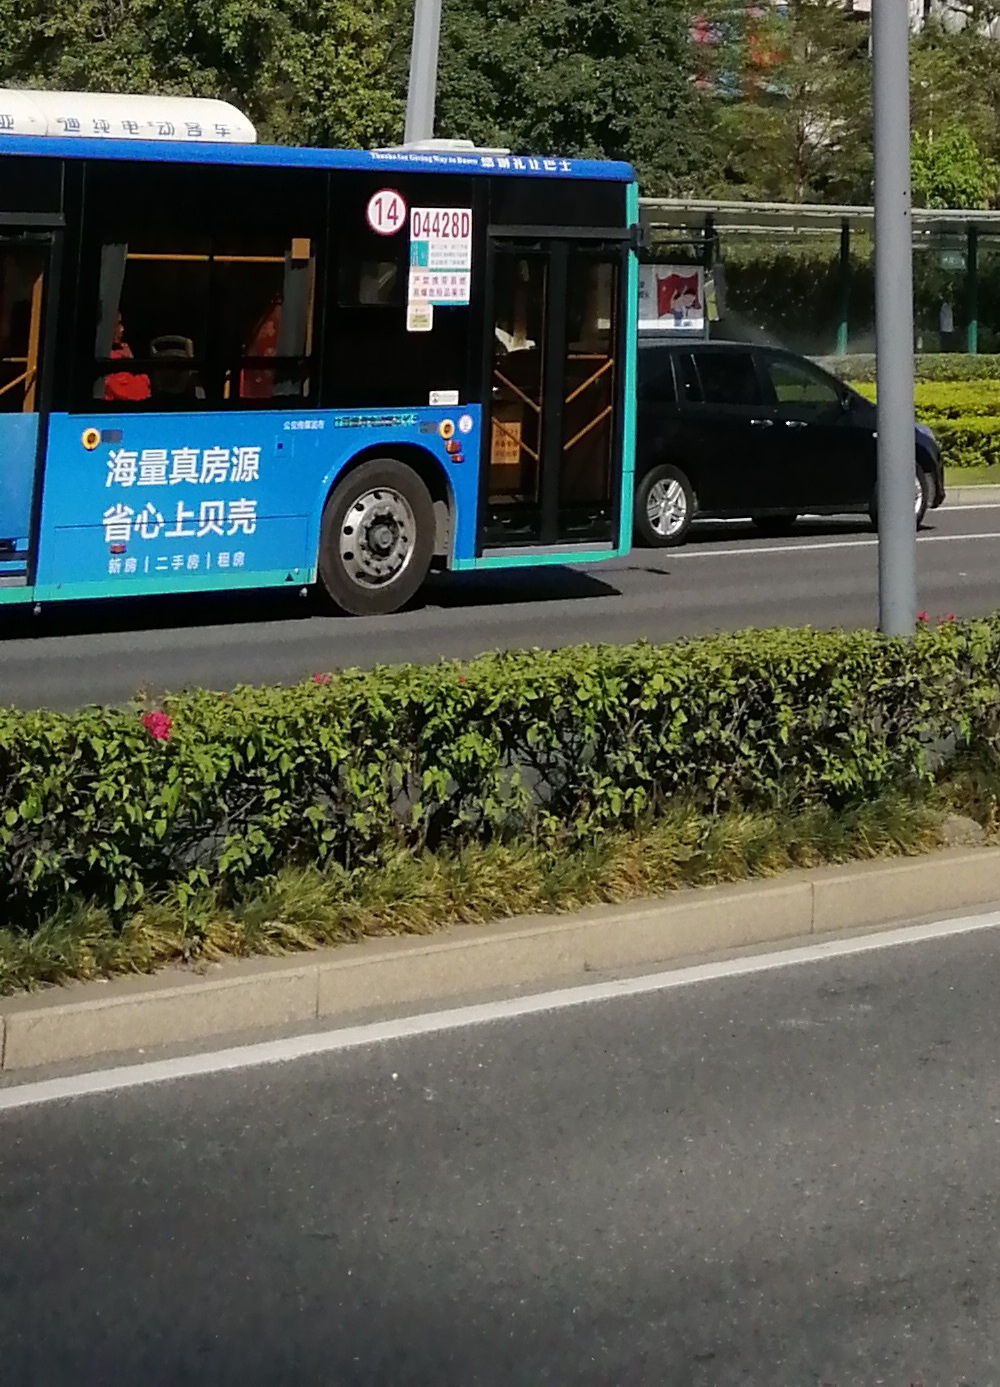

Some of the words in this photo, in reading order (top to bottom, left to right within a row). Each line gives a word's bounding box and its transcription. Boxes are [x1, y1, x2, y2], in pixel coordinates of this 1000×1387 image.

[375, 197, 399, 226] 14
[412, 211, 470, 239] 04428D
[105, 446, 262, 488] 海量真房源
[102, 498, 258, 543] 省心上贝壳
